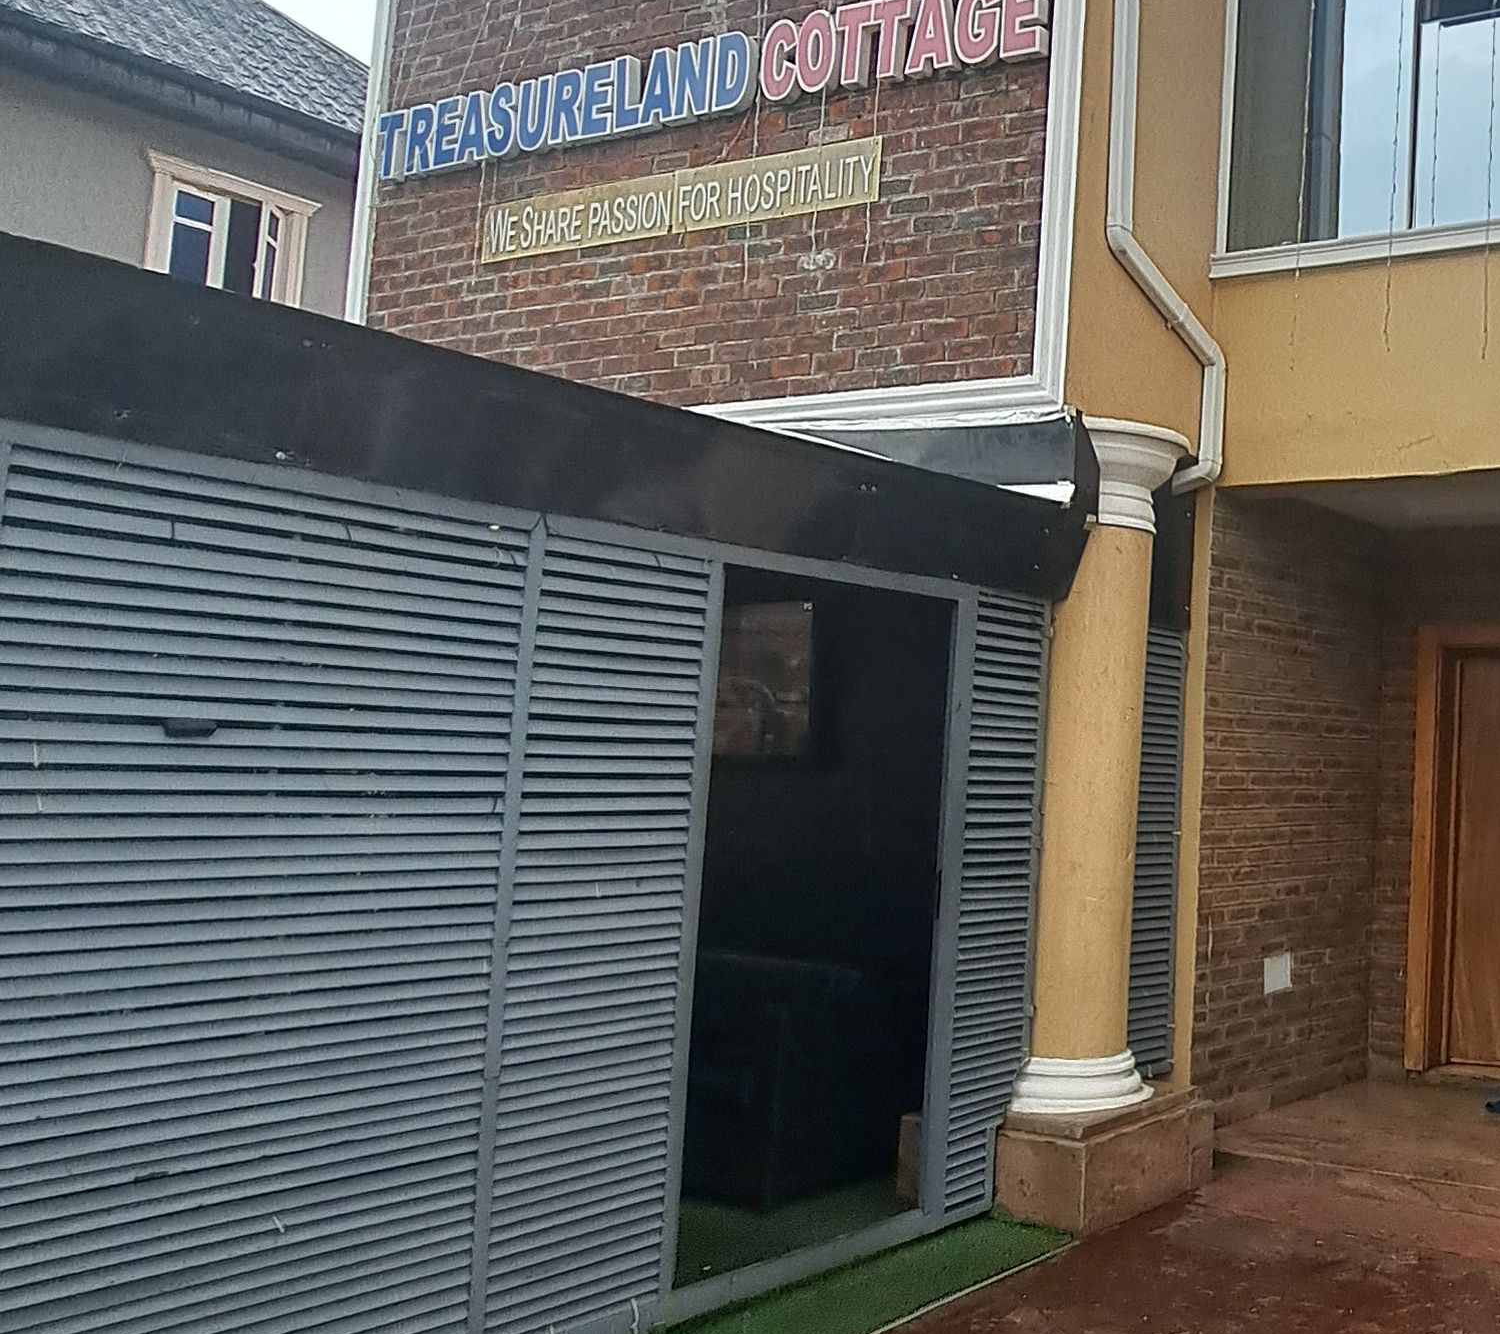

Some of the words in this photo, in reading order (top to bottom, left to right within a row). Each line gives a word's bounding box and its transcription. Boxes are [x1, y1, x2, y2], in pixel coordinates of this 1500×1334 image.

[379, 30, 752, 180] TREASURELAND
[587, 189, 673, 236] PASSION
[677, 180, 721, 223] FOR
[726, 153, 875, 215] HOSPITALITY
